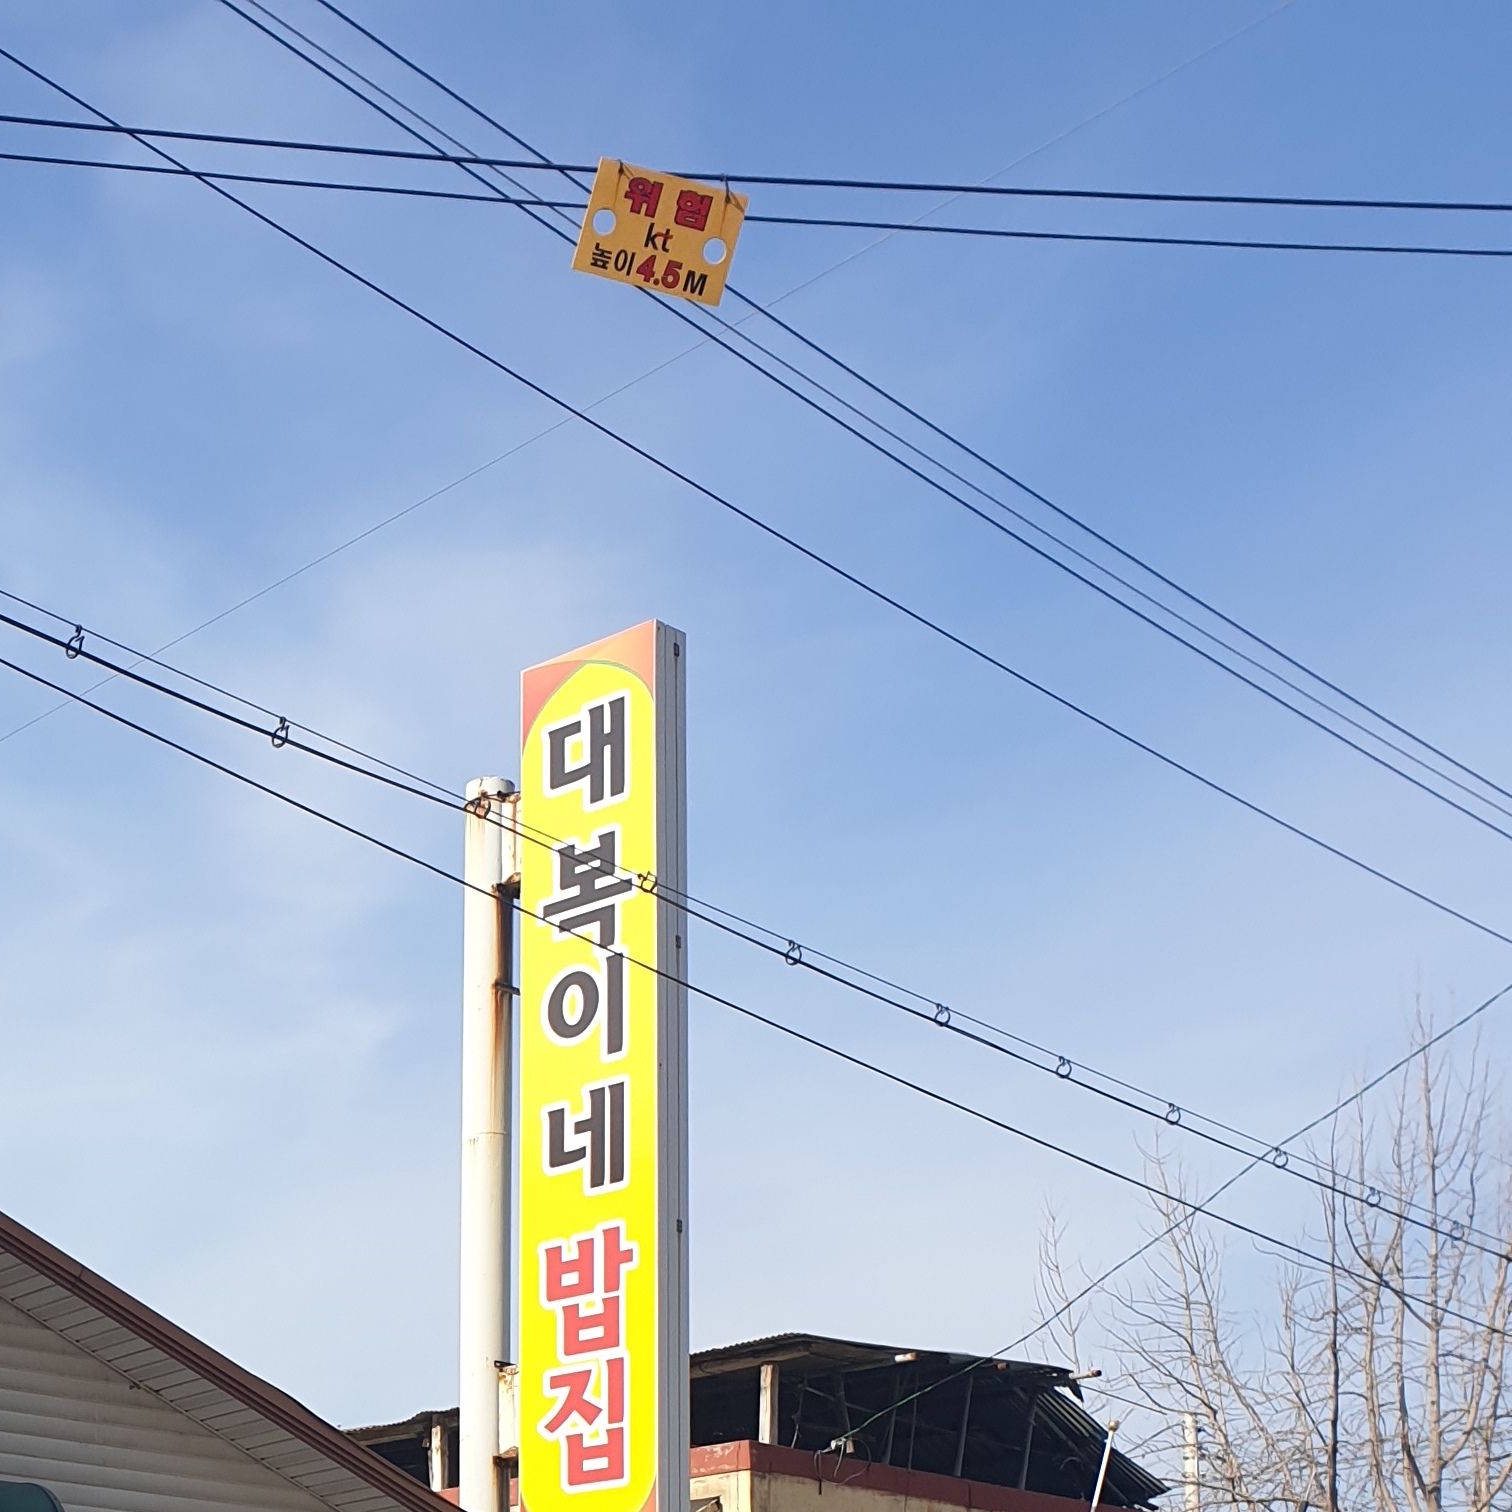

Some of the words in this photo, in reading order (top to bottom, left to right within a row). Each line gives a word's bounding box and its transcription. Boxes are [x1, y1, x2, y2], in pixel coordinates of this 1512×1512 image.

[644, 222, 674, 253] kt
[543, 696, 633, 1189] 대복이네
[544, 1225, 634, 1487] 밥집
